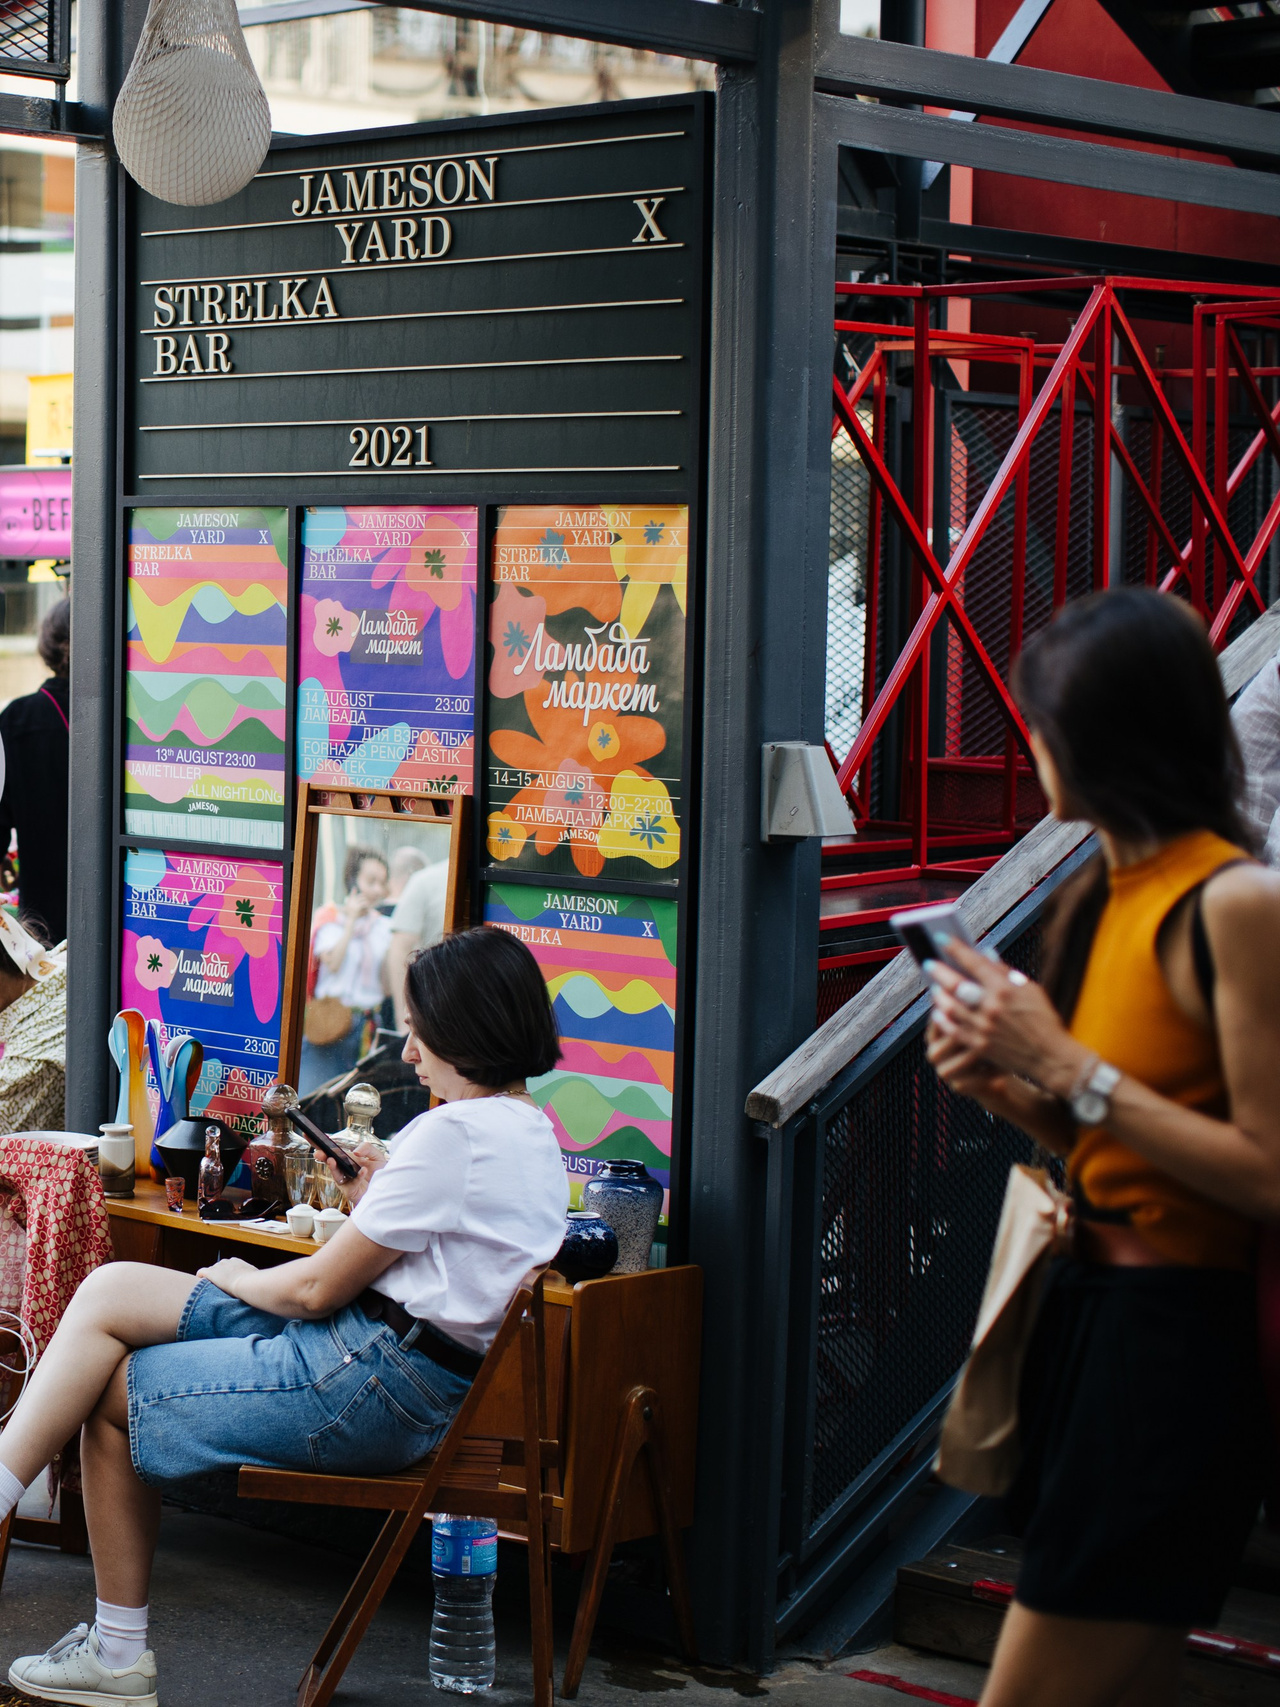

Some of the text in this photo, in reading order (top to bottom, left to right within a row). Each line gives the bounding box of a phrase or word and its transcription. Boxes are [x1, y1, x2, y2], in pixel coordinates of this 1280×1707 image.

[291, 156, 500, 218] JAMESON
[334, 196, 668, 264] YARD X
[152, 275, 339, 328] STRELKA
[152, 331, 232, 376] BAR
[347, 423, 434, 468] 2021
[32, 498, 69, 531] BEF
[176, 513, 239, 527] JAMESON
[359, 514, 426, 529] JAMESON
[555, 511, 631, 527] JAMESON
[189, 530, 269, 544] YARD X
[373, 531, 471, 546] YARD X
[571, 530, 681, 546] YARD X
[134, 546, 193, 560] STRELKA
[309, 548, 373, 563] STRELKA
[499, 548, 571, 563] STRELKA
[134, 562, 160, 576] BAR
[309, 564, 337, 579] BAR
[499, 565, 531, 581] BAR
[351, 610, 418, 638] Ламбада
[365, 639, 423, 662] маркет
[513, 621, 651, 676] Ламбада
[306, 692, 470, 712] 14 AUGUST 23:00
[542, 680, 660, 727] маркет
[304, 708, 367, 725] ЛАМБАДА
[361, 727, 469, 746] ДЛЯ ВЗРОСЛЫХ
[156, 748, 256, 767] 13th AUGUST 23:00
[371, 745, 461, 763] PENOPLASTIK
[128, 763, 202, 780] JAMIE TILLER
[304, 757, 367, 774] DISKOTEK
[536, 773, 595, 790] AUGUST
[187, 784, 283, 803] ALL NIGHT LONG
[187, 801, 220, 814] JAMESON
[515, 806, 651, 830] ЛАМБАДА-МАРКЕТ
[558, 829, 600, 843] JAMESON
[176, 859, 239, 878] JAMESON
[131, 886, 190, 906] STRELKA
[189, 876, 277, 899] YARD X
[131, 902, 158, 918] BAR
[543, 892, 619, 915] JAMESON
[559, 912, 654, 937] YARD X
[170, 950, 230, 979] Ламбада
[182, 977, 234, 1002] маркет
[160, 1025, 275, 1055] GUST 23:00
[207, 1064, 275, 1086] ВЗРОСЛЫХ
[194, 1079, 267, 1102] NOPLASTIK
[561, 1154, 596, 1174] GUST
